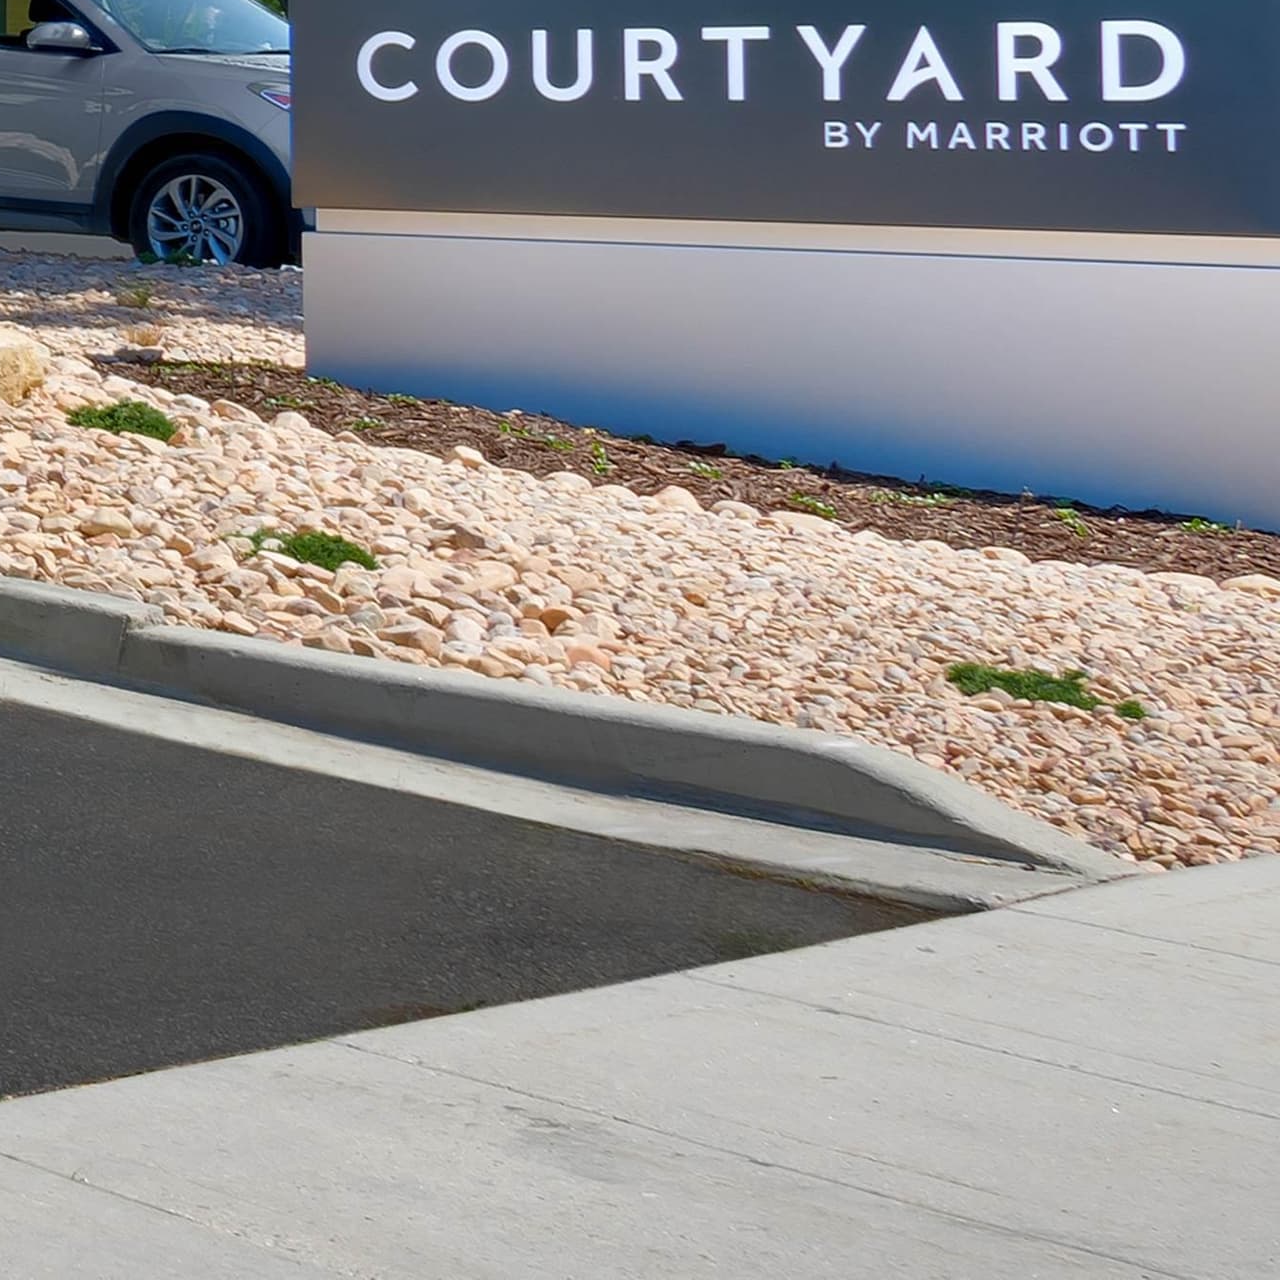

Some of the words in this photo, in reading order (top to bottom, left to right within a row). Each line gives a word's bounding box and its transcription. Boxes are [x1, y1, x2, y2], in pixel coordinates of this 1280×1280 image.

[357, 20, 1186, 102] COURTYARD
[824, 121, 882, 149] BY
[907, 121, 1187, 153] MARRIOTT
